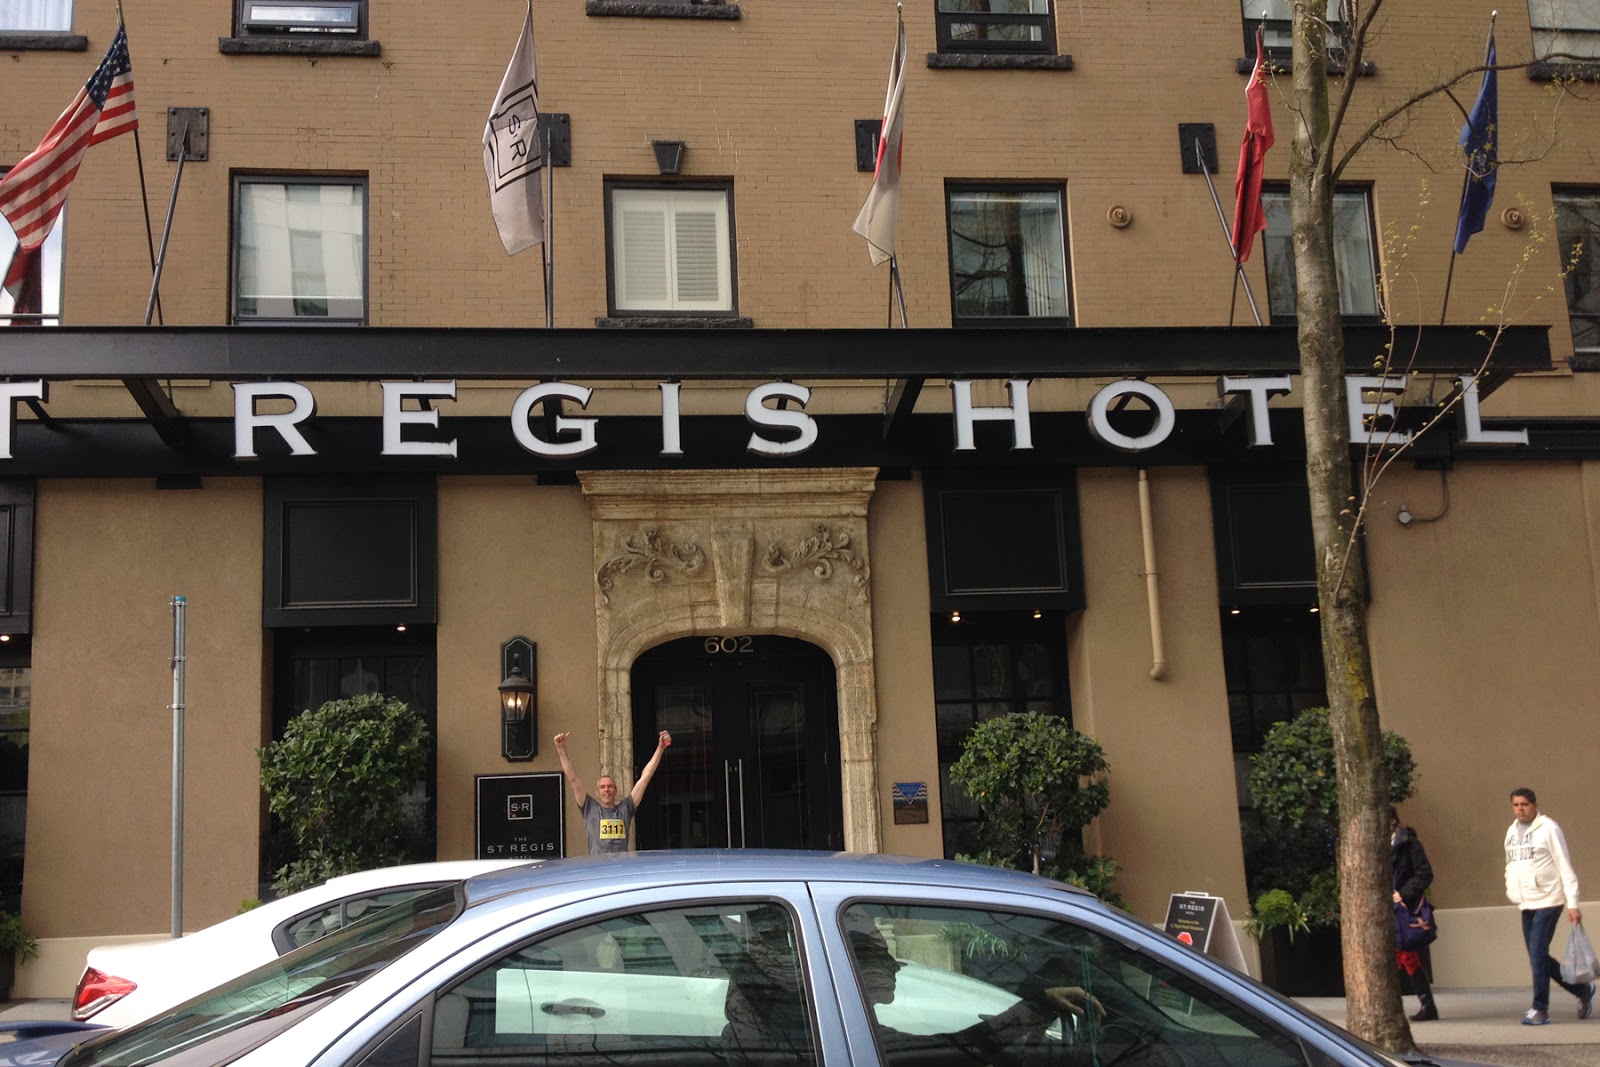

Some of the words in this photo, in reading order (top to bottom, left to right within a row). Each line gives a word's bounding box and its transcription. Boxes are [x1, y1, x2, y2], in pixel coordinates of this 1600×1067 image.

[231, 380, 819, 458] REGIS
[949, 375, 1530, 451] HOTEL
[705, 636, 754, 654] 602
[602, 824, 624, 834] 3117
[510, 842, 555, 852] REGIS
